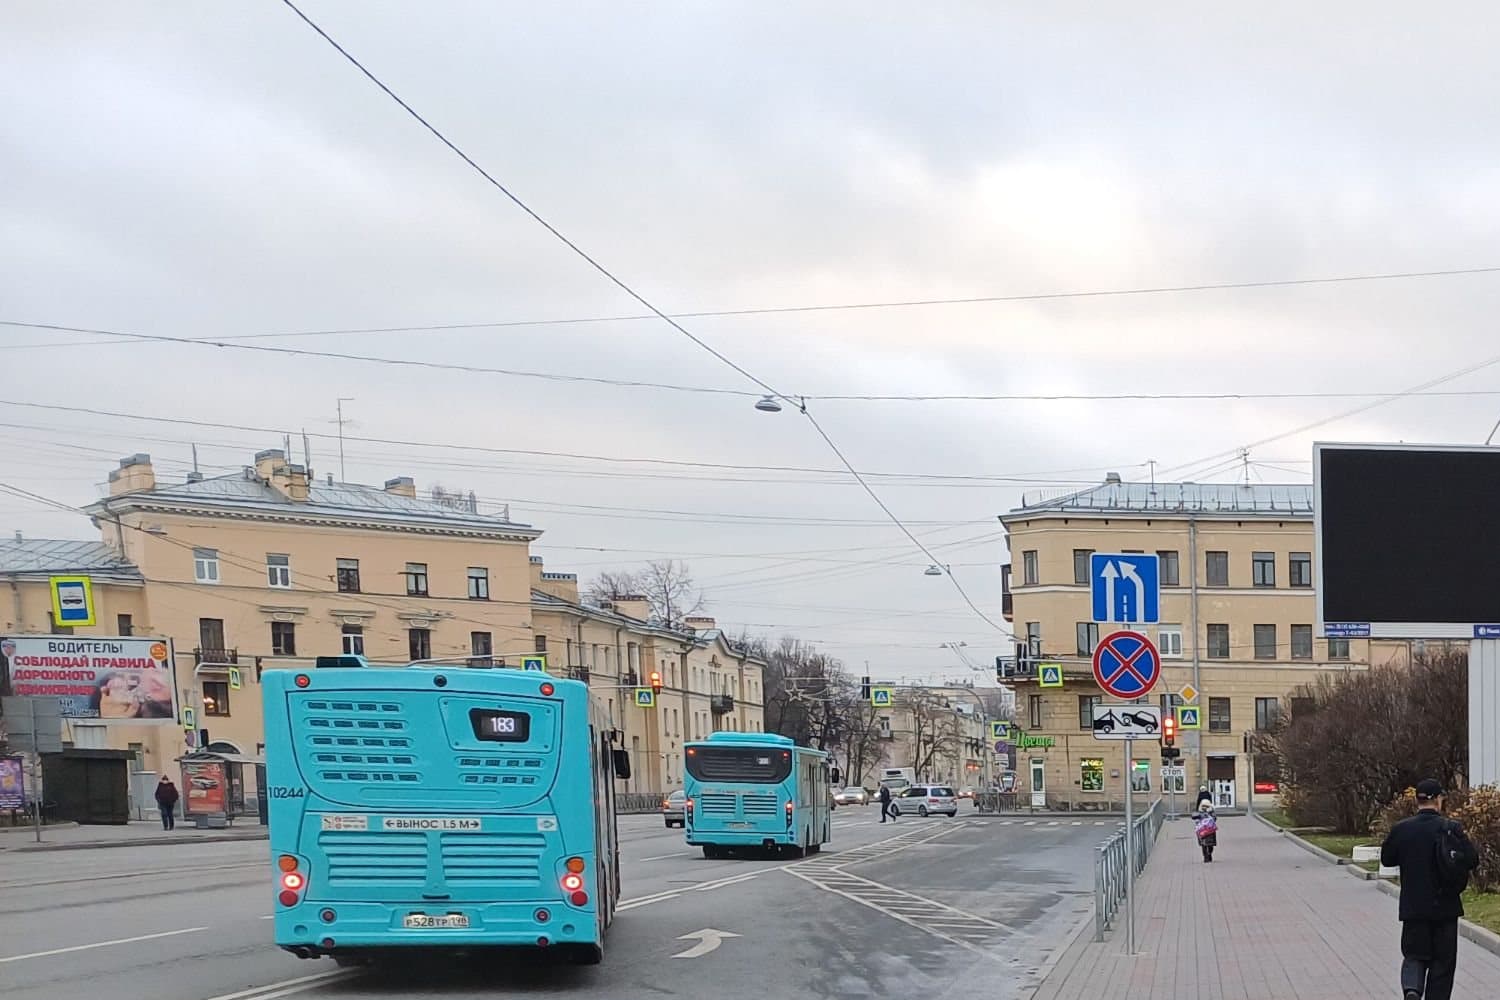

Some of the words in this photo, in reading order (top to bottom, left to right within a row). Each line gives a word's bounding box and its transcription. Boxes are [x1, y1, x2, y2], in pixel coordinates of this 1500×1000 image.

[14, 655, 89, 669] СОБЛЮДАЙ
[93, 657, 156, 669] ПРАВИЛА
[14, 669, 96, 681] ДОРОЖНОГО
[490, 717, 515, 732] 183
[269, 786, 304, 799] 10244
[395, 820, 439, 829] ВЫНОС
[459, 820, 470, 829] М
